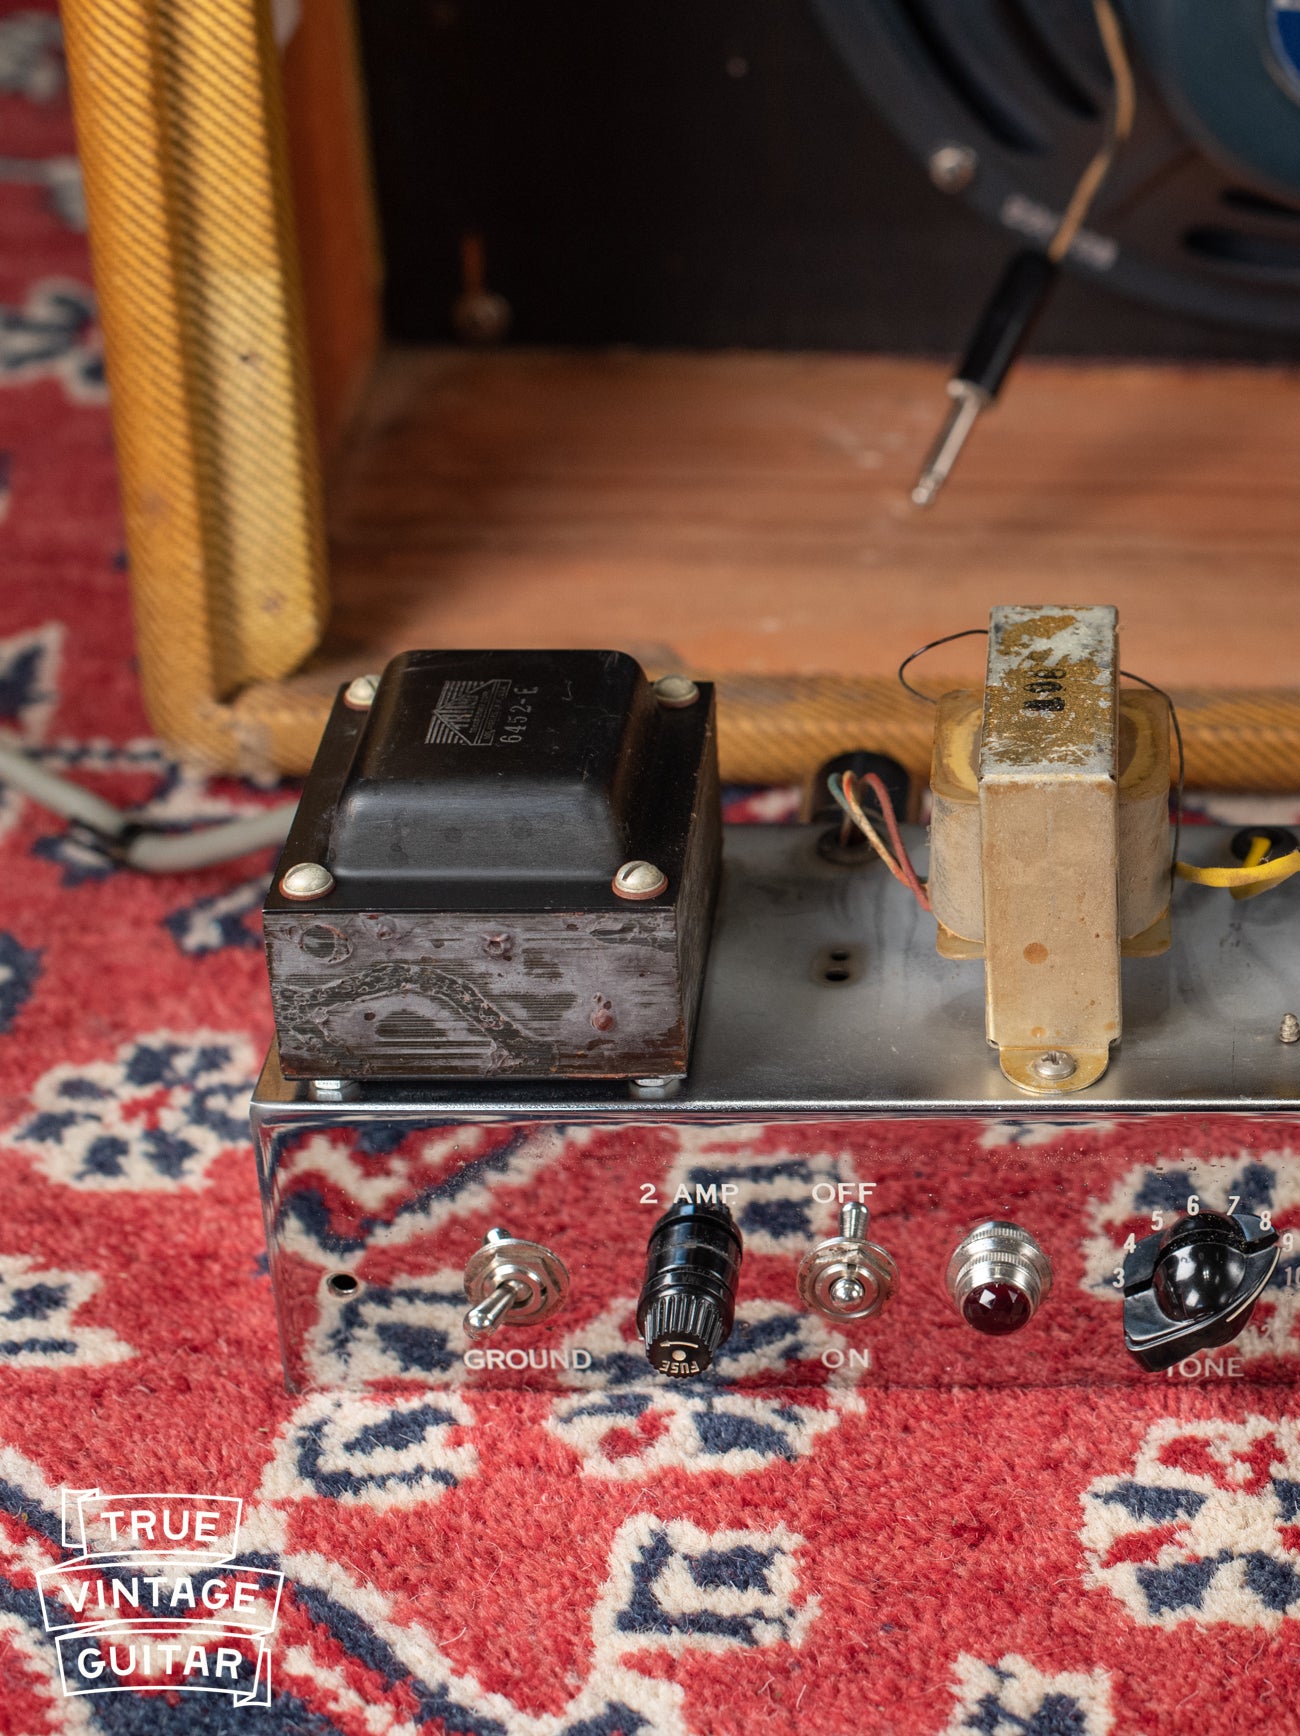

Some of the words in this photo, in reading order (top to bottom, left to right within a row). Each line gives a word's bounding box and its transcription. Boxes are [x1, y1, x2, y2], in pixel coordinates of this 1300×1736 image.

[500, 686, 539, 743] 6452-E
[639, 1183, 658, 1204] 2
[811, 1182, 877, 1204] OFF
[1187, 1195, 1199, 1215] 6
[1227, 1196, 1240, 1215] 7
[1151, 1211, 1163, 1230] 5
[1260, 1211, 1272, 1230] 8
[1124, 1233, 1136, 1253] 4
[1282, 1234, 1294, 1252] 9
[1113, 1268, 1125, 1288] 3
[463, 1348, 592, 1371] GROUND
[659, 1360, 700, 1374] FUSE
[821, 1348, 870, 1369] ON
